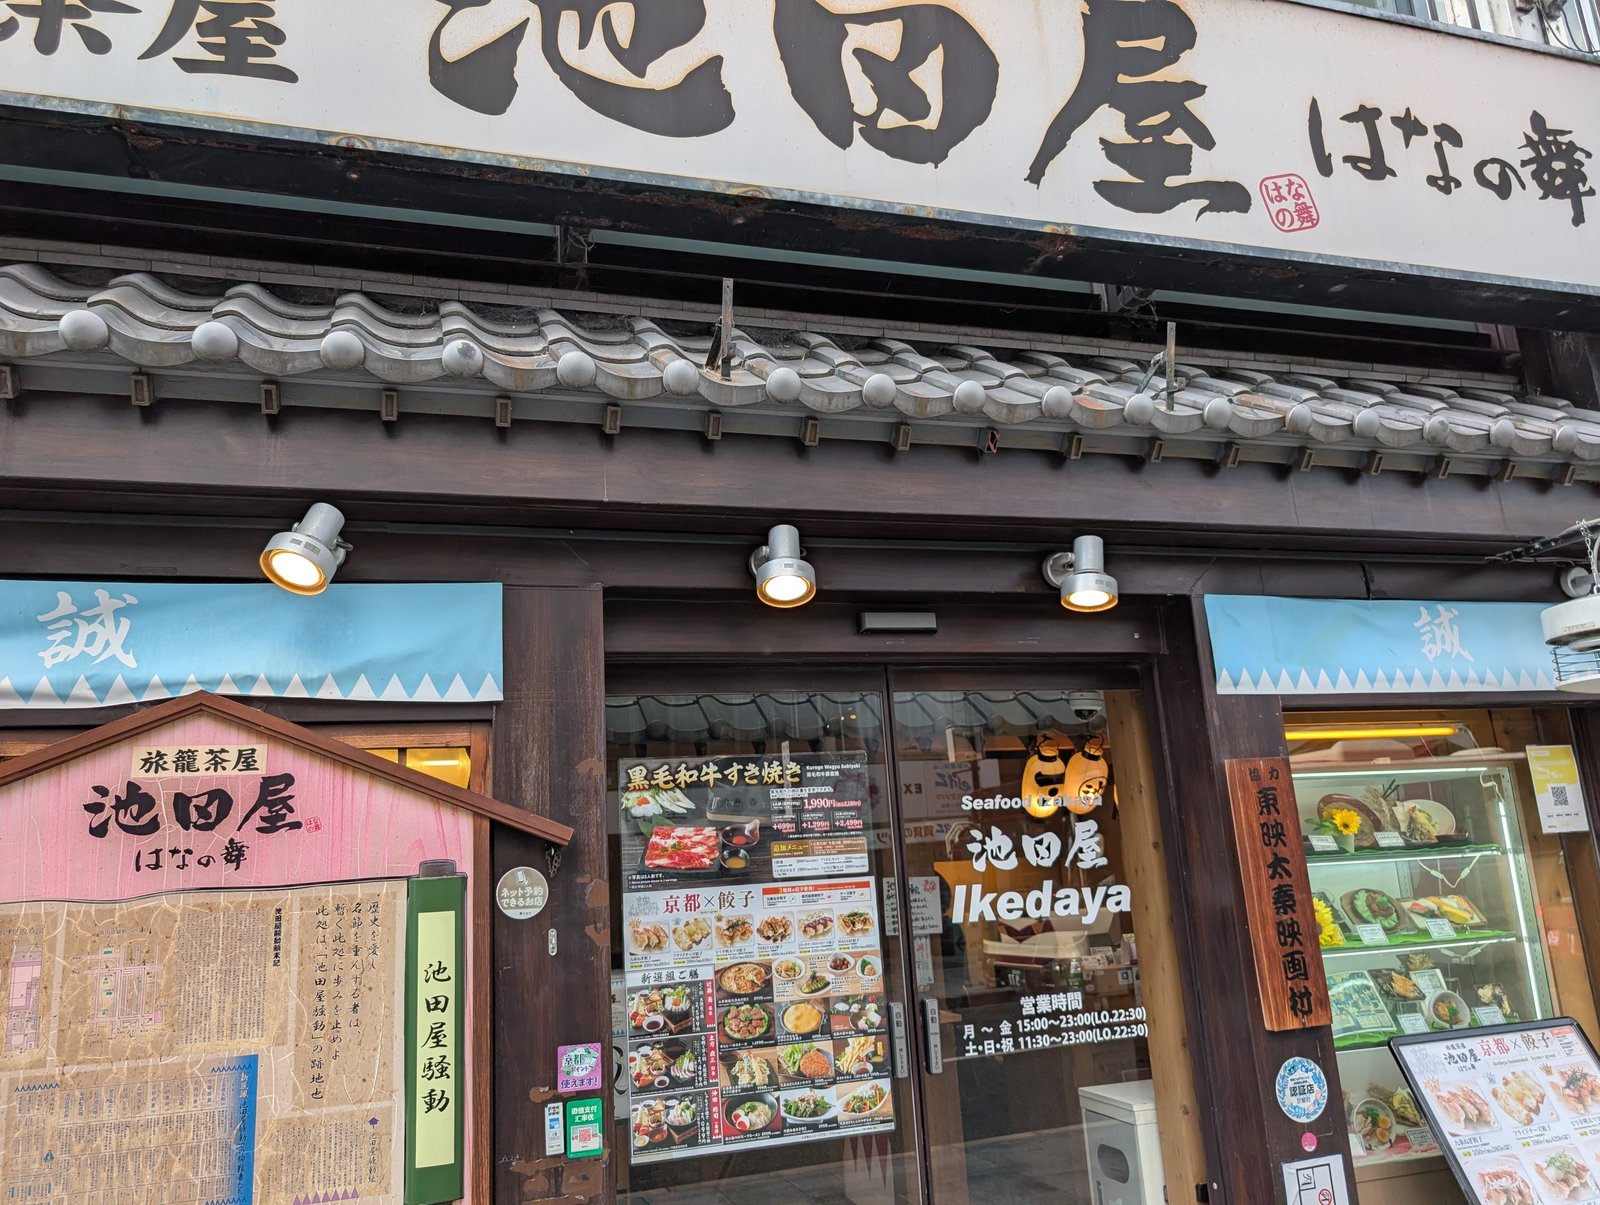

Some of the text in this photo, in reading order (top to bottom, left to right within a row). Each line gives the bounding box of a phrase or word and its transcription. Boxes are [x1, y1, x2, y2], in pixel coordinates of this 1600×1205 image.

[1307, 95, 1595, 228] はなの舞
[37, 587, 139, 669] 誠
[1413, 604, 1475, 663] 誠
[138, 746, 260, 775] 旅籠茶屋
[626, 761, 802, 792] 黒毛和牛すき焼き
[83, 772, 304, 839] 池田屋
[961, 793, 1032, 811] Seafood
[1037, 792, 1103, 809] Izakaya
[135, 837, 250, 873] はなの舞
[966, 819, 1109, 873] 池田屋
[500, 886, 544, 898] ネット予約
[500, 896, 544, 908] できるお店
[662, 890, 756, 915] 京都×餃子
[951, 879, 1132, 924] Ikedaya
[1256, 786, 1313, 1018] 東映太秦映画村
[367, 900, 381, 971] 歴史を愛し
[641, 968, 700, 984] 新選組ご膳
[1020, 991, 1083, 1015] 営業時間
[421, 960, 452, 1114] 池田屋騒動
[1477, 1031, 1552, 1057] 京都×餃子
[1443, 1048, 1481, 1066] 池田屋
[1289, 1084, 1315, 1097] 認証店
